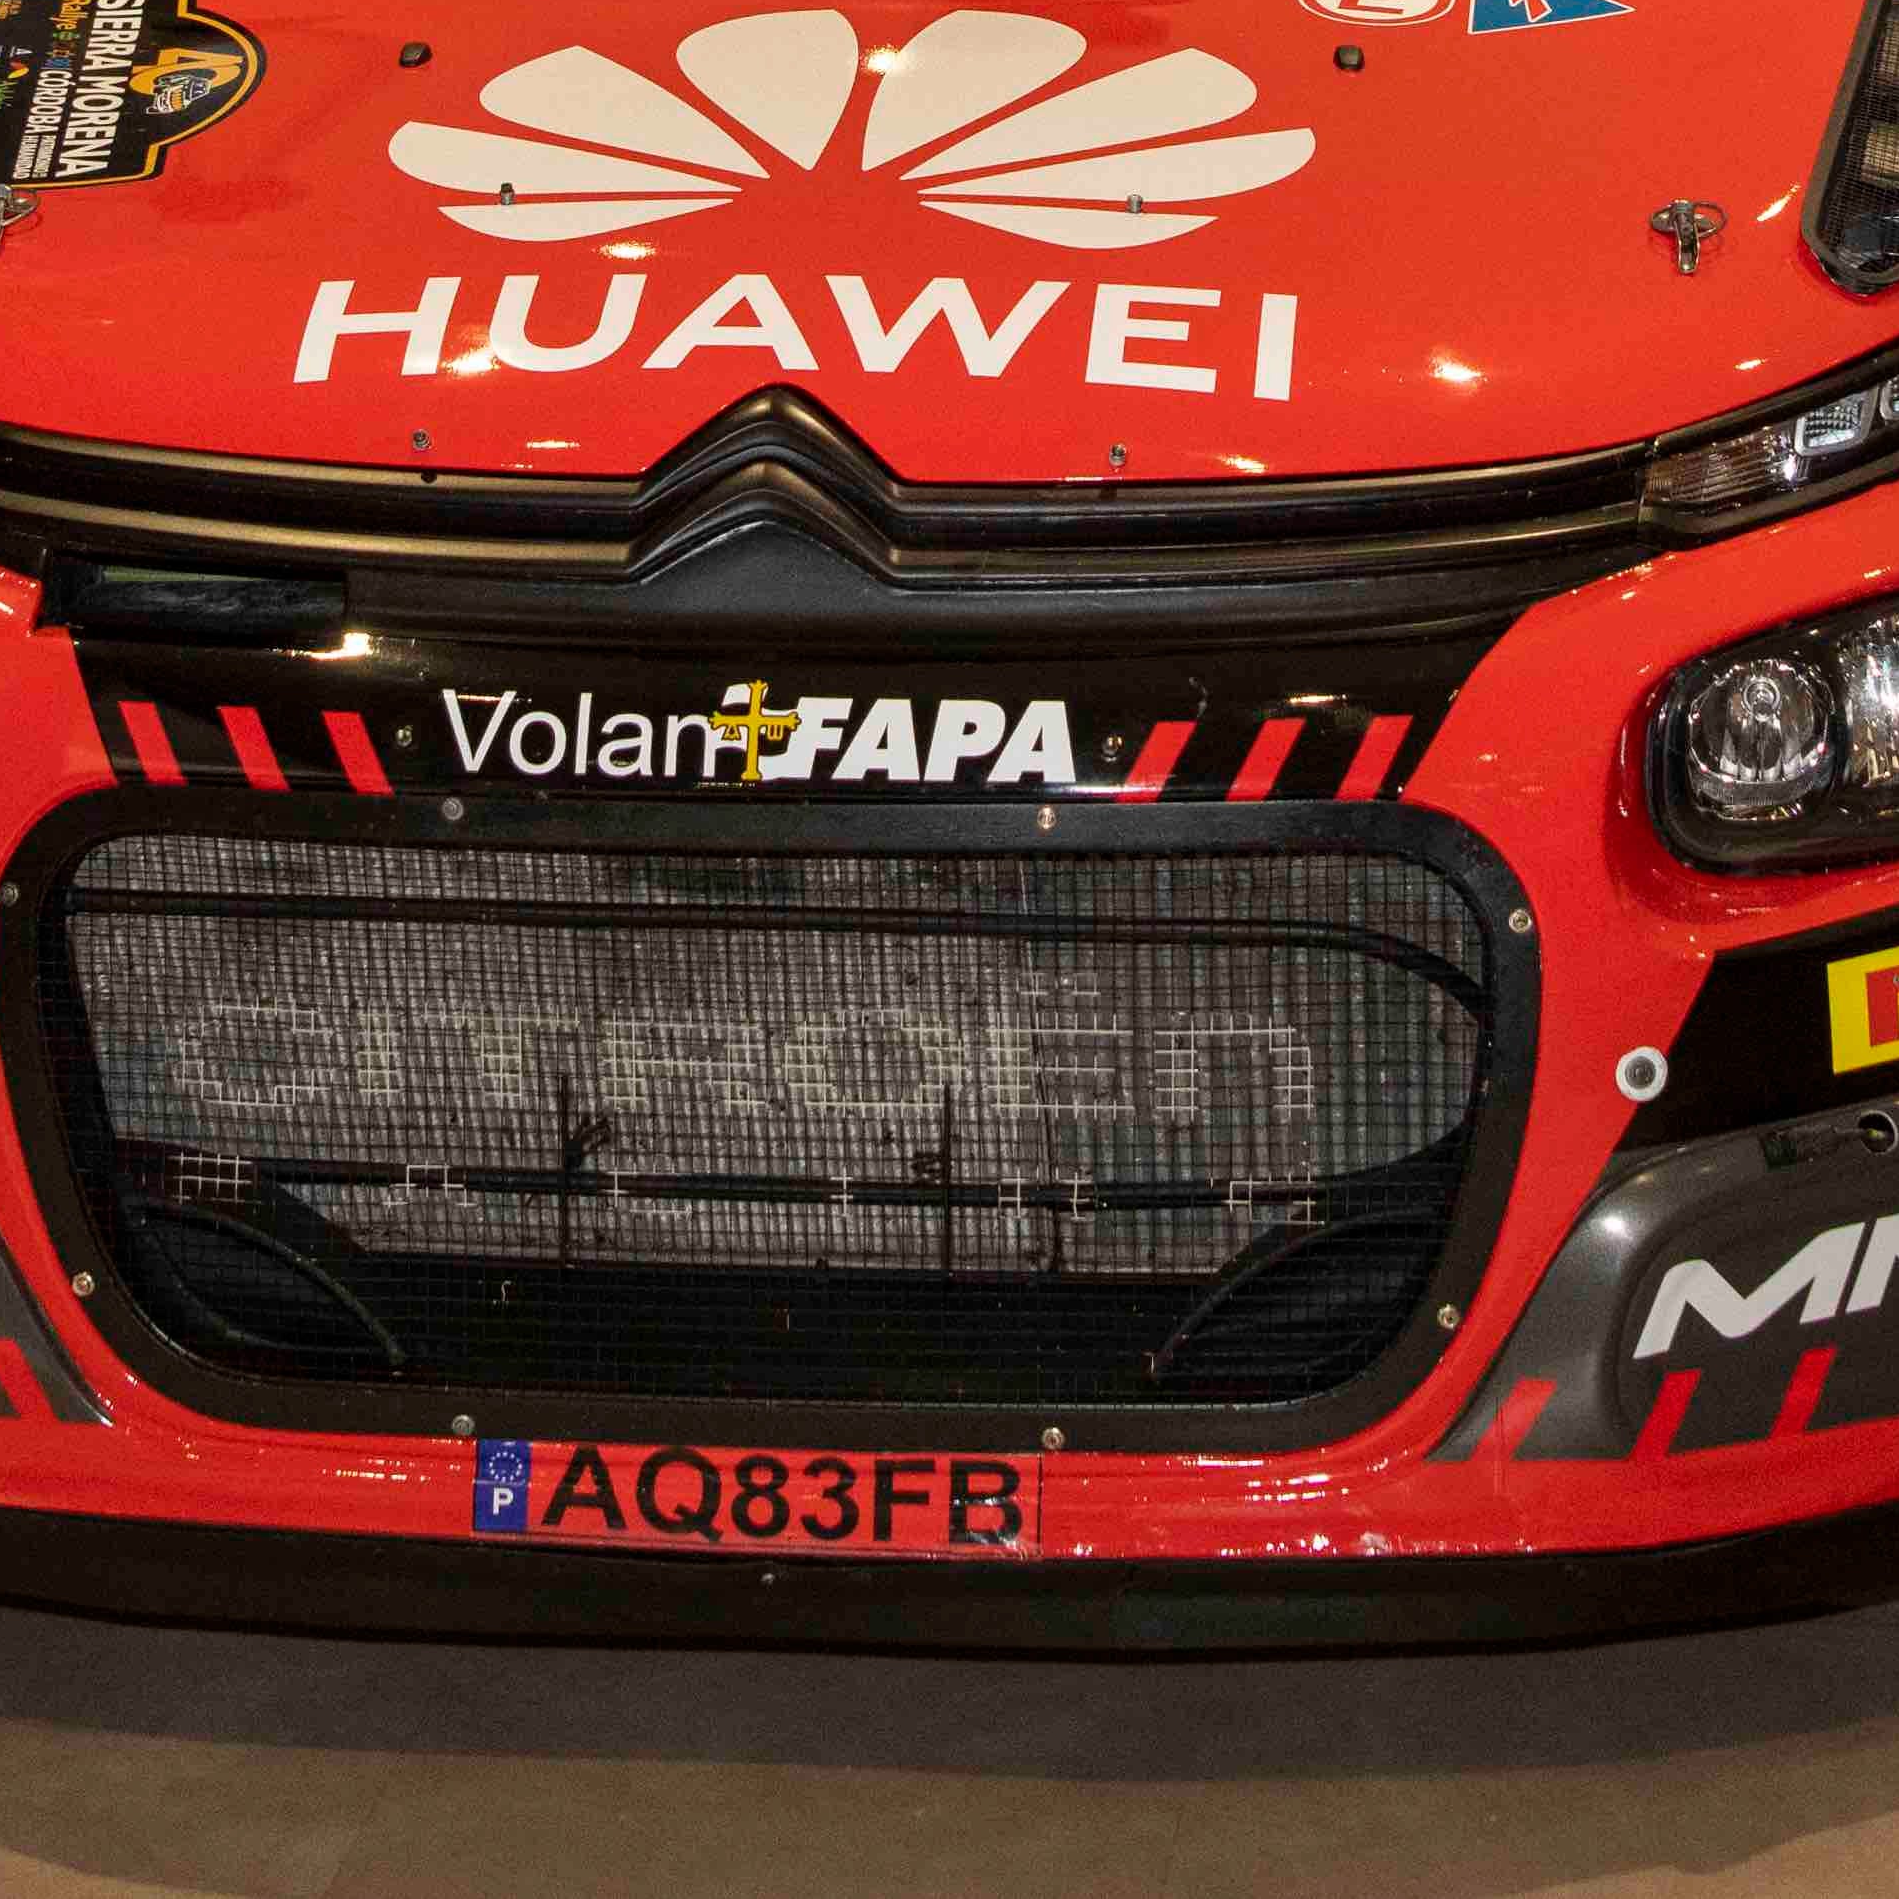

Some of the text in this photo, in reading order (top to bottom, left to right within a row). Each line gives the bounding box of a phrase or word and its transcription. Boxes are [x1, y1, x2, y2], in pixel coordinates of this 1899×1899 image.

[23, 69, 79, 135] CÓRDOBA
[54, 75, 129, 178] MORENA
[293, 273, 1298, 402] HUAWEI
[492, 1442, 1024, 1547] P AQ83FB
